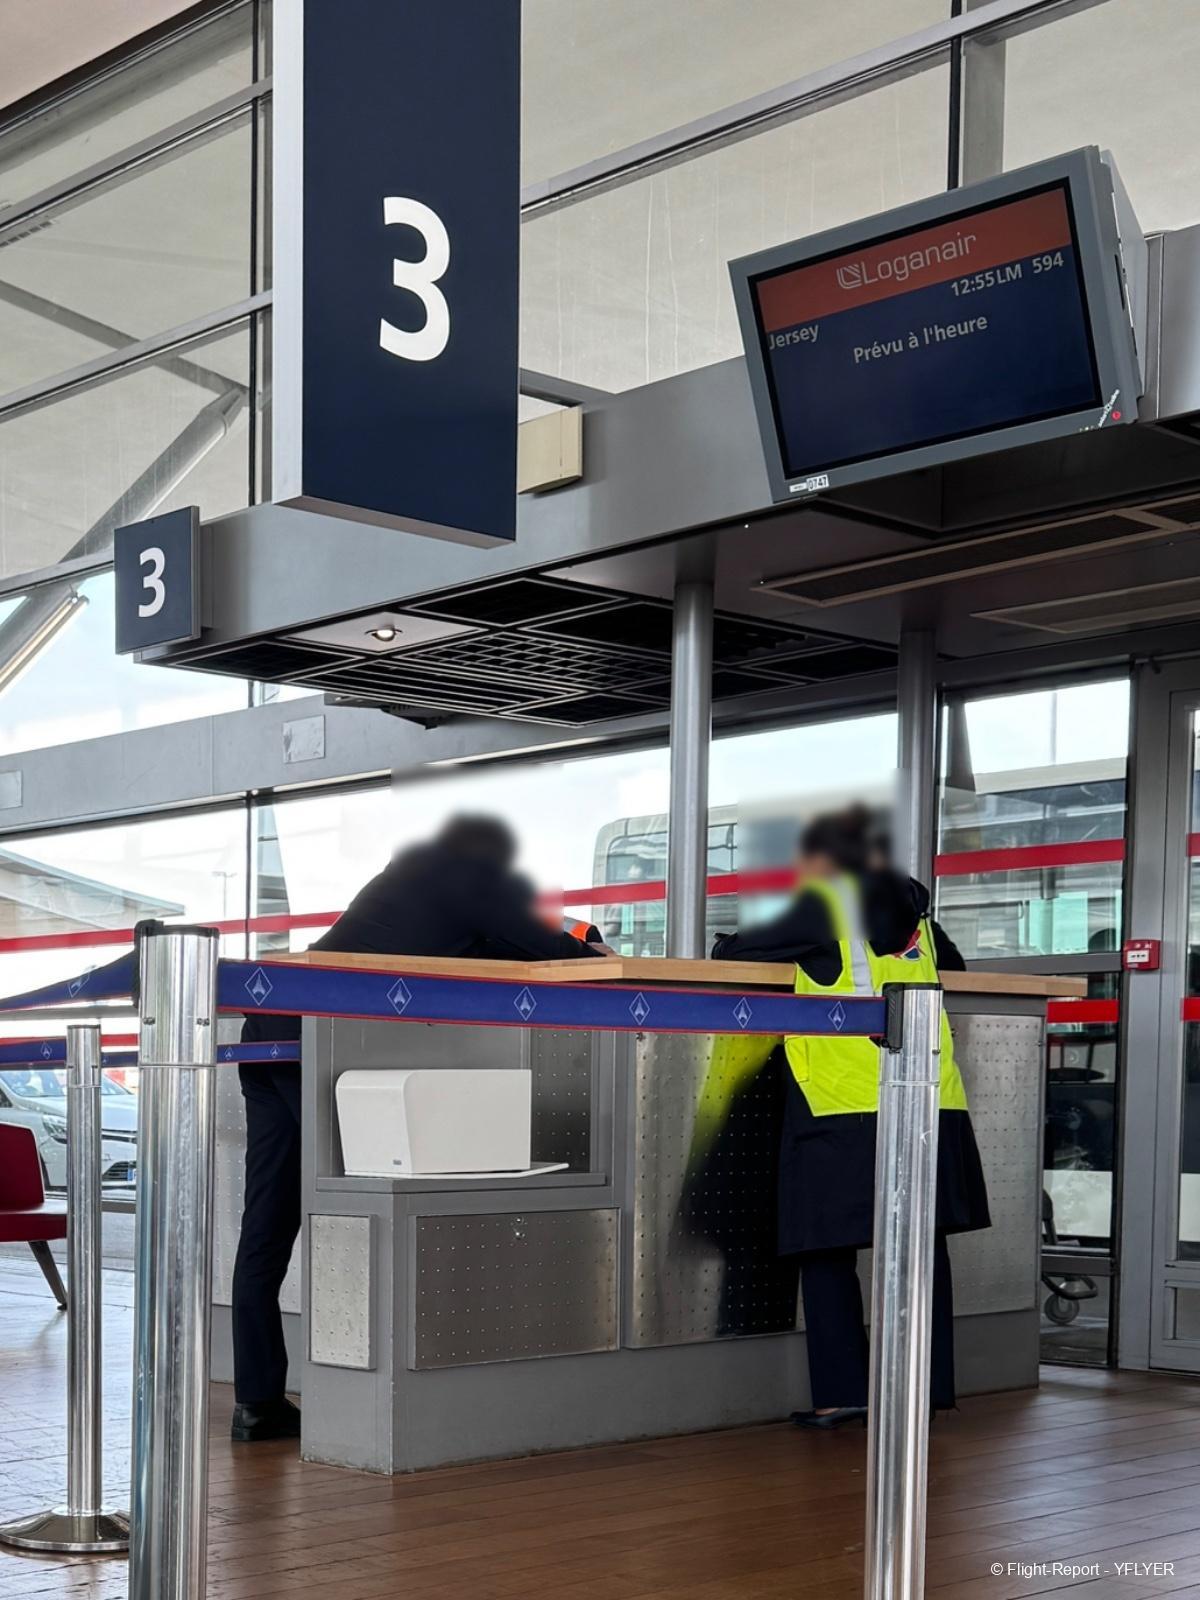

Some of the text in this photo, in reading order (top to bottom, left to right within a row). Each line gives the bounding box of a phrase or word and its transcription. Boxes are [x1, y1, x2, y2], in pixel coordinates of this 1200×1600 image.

[379, 196, 451, 362] 3
[862, 232, 977, 284] Loganair
[951, 252, 1064, 296] 12:55 LM 594
[769, 325, 819, 350] Jersey
[853, 316, 988, 363] Prévu à l'heure
[138, 547, 166, 618] 3
